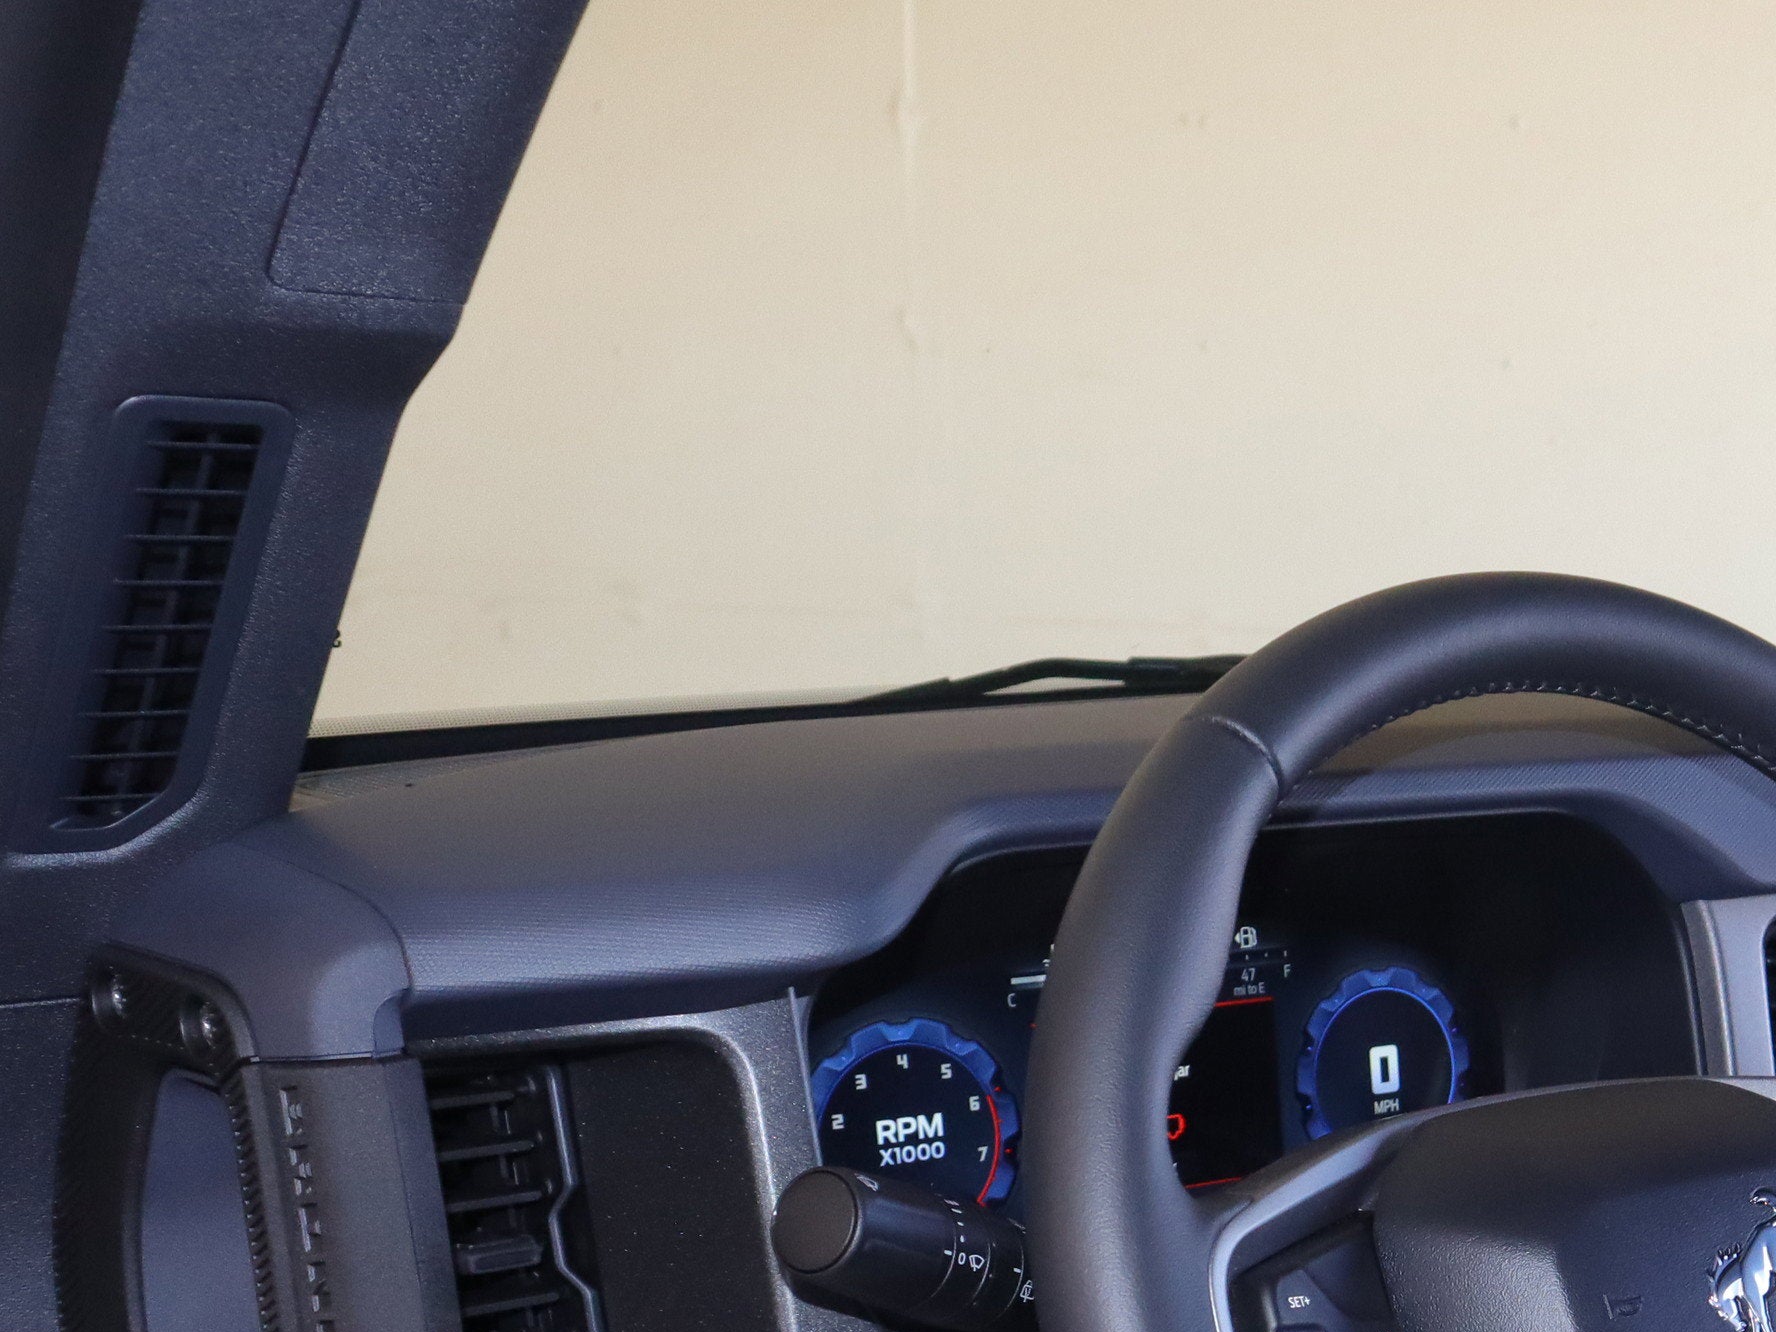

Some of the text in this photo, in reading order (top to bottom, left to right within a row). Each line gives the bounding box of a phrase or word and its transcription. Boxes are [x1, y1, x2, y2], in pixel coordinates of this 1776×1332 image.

[1240, 967, 1256, 982] 47
[1283, 963, 1291, 978] F
[1247, 983, 1258, 995] to
[1258, 981, 1266, 994] E
[896, 1053, 910, 1070] 4
[1369, 1044, 1400, 1095] 0
[940, 1063, 953, 1080] 5
[854, 1073, 868, 1090] 3
[968, 1095, 981, 1111] 6
[1373, 1097, 1400, 1116] MPH
[831, 1113, 845, 1130] 2
[875, 1112, 944, 1146] RPM
[879, 1141, 946, 1167] X1000
[977, 1145, 989, 1162] 7
[1288, 1295, 1311, 1309] SET+
